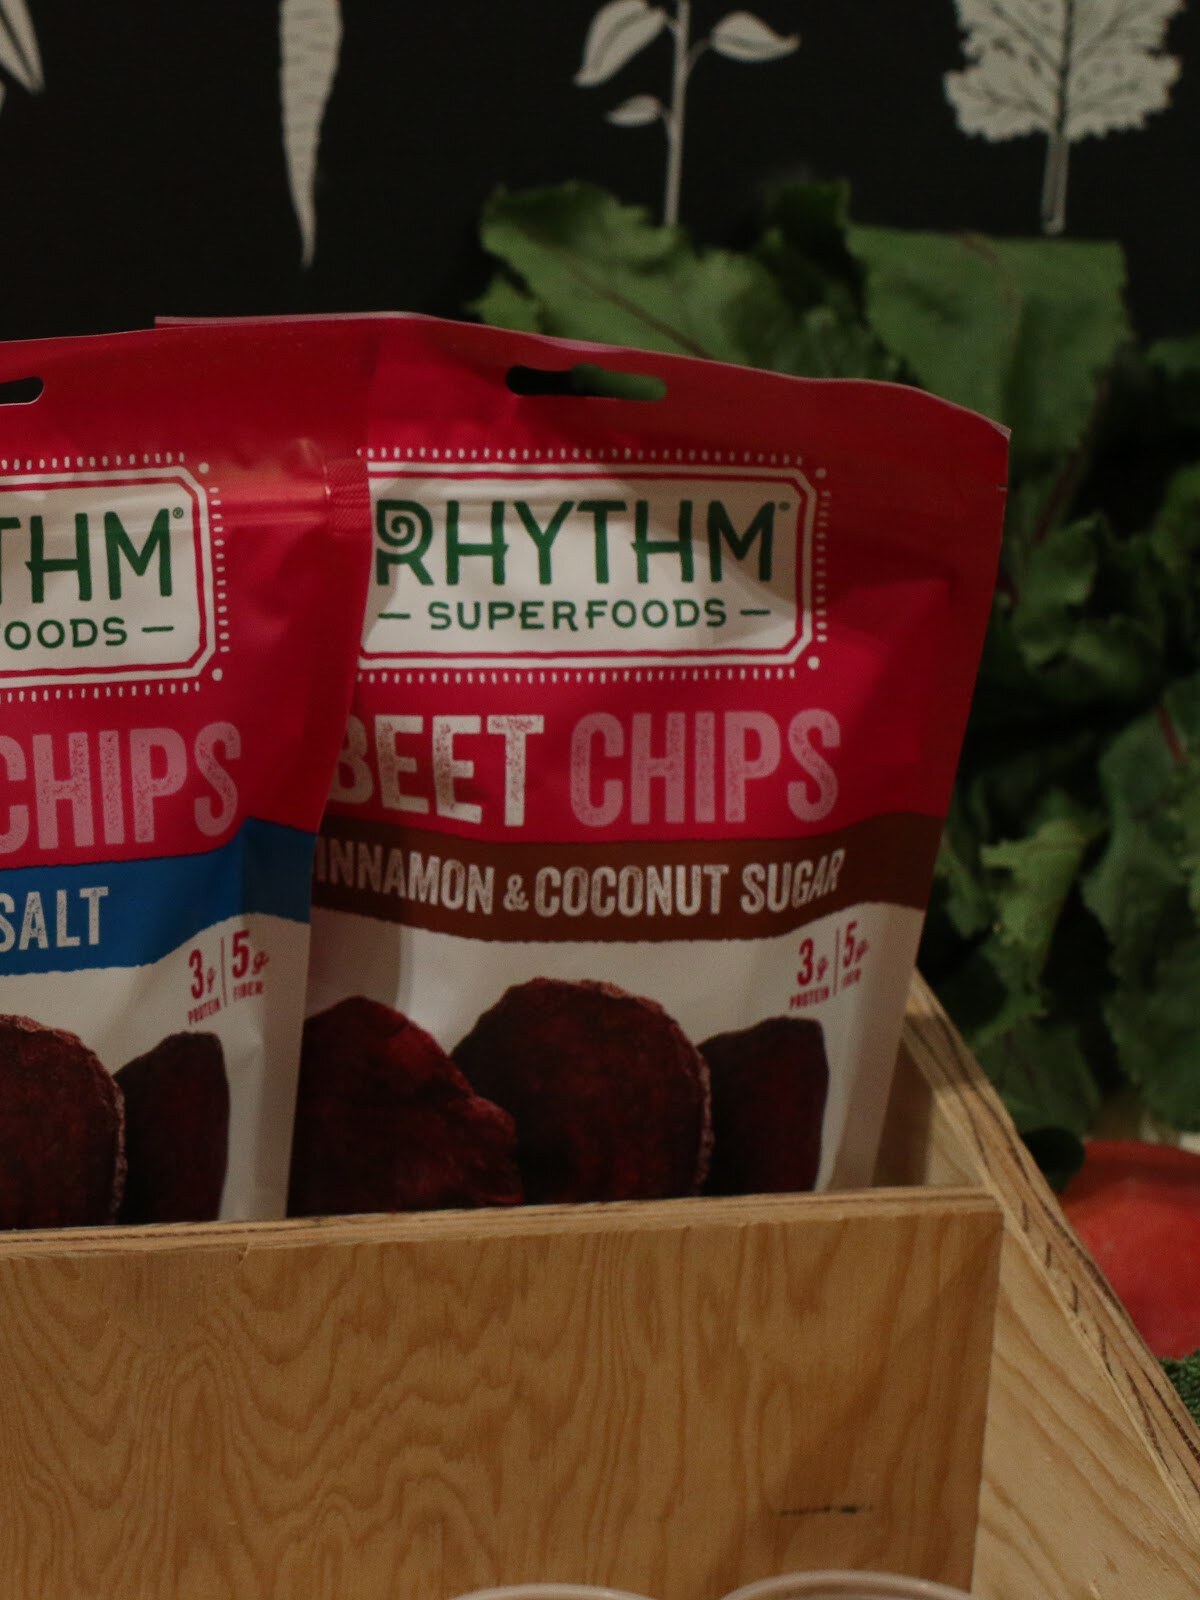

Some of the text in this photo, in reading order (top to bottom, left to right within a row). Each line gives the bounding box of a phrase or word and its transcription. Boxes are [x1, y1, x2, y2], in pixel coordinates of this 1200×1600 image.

[375, 500, 777, 586] RHYTHM
[429, 599, 727, 633] SUPERFOODS
[569, 708, 842, 828] CHIPS
[316, 836, 846, 918] INNAMON & COCONUT SUGAR
